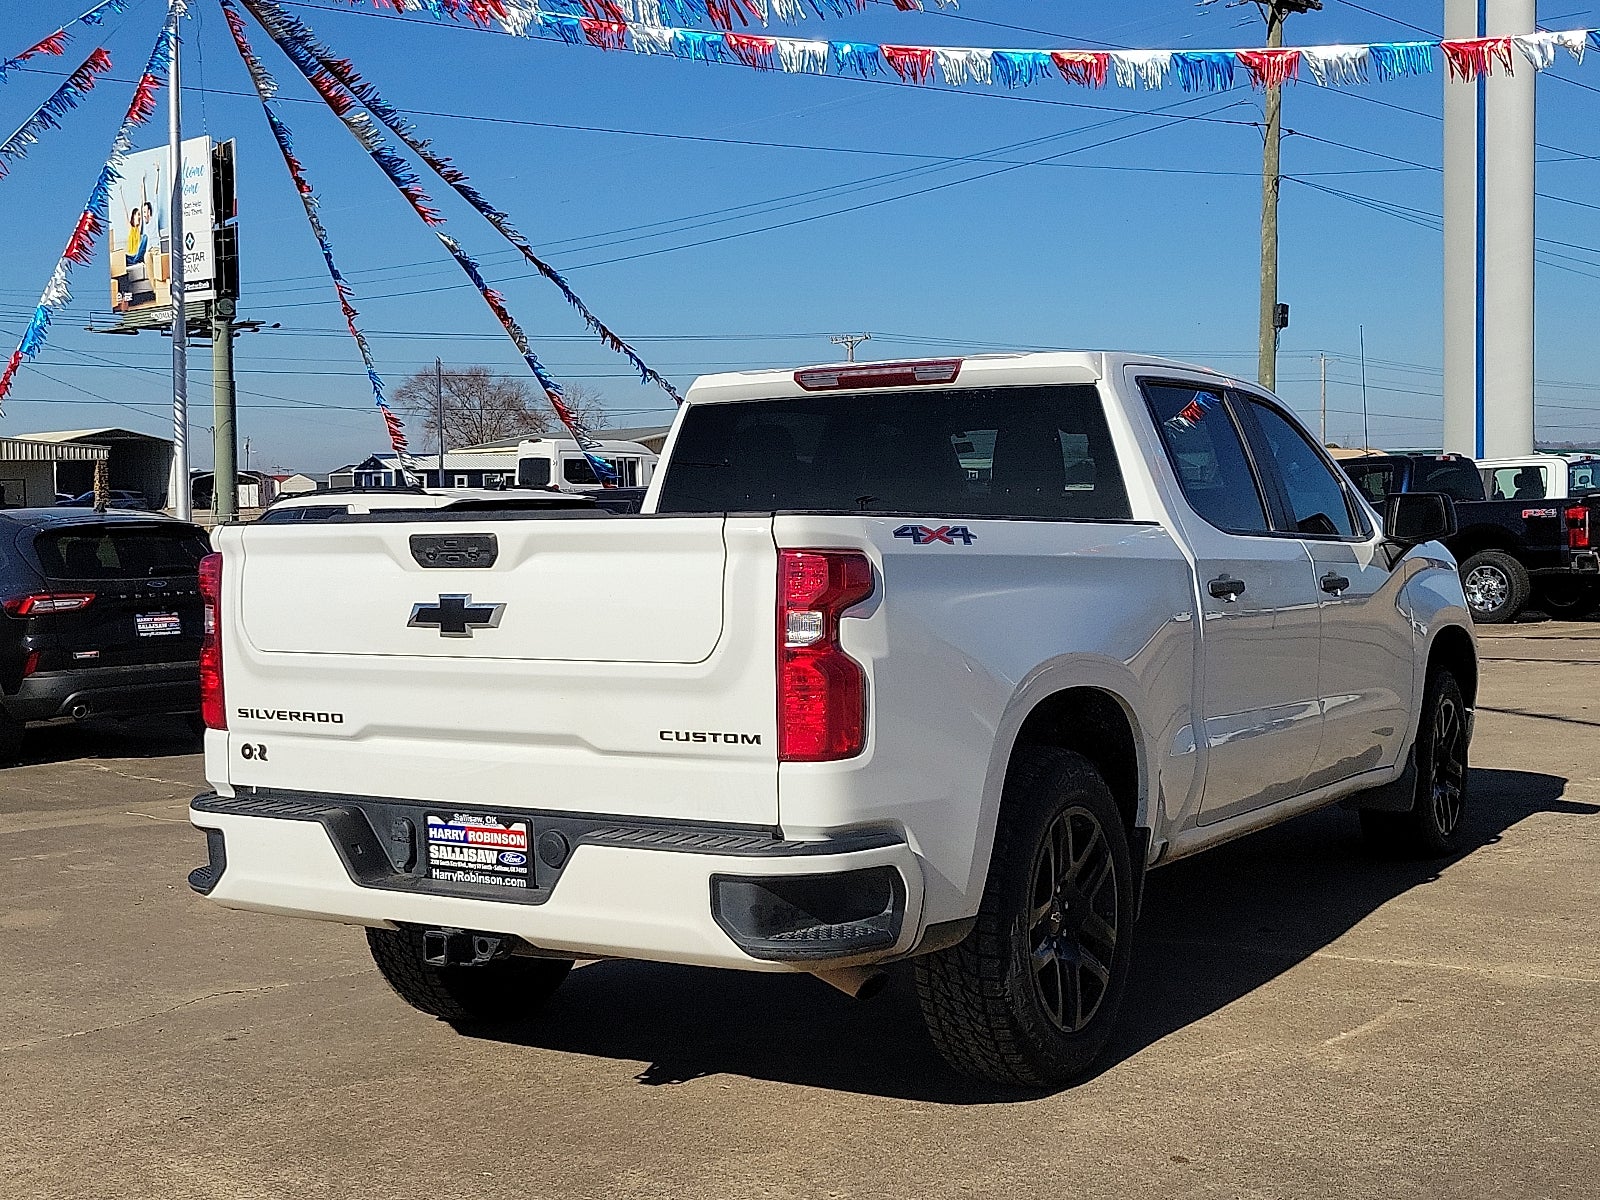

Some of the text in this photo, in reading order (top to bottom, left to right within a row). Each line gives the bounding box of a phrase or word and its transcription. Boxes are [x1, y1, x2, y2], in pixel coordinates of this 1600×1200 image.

[237, 708, 344, 724] SILVERADO
[659, 730, 762, 745] CUSTOM
[485, 815, 498, 825] OK
[428, 827, 525, 846] HARRY ROBINSON
[429, 845, 523, 864] SALLISAW Ford
[432, 869, 527, 887] HarryRobinson.com
